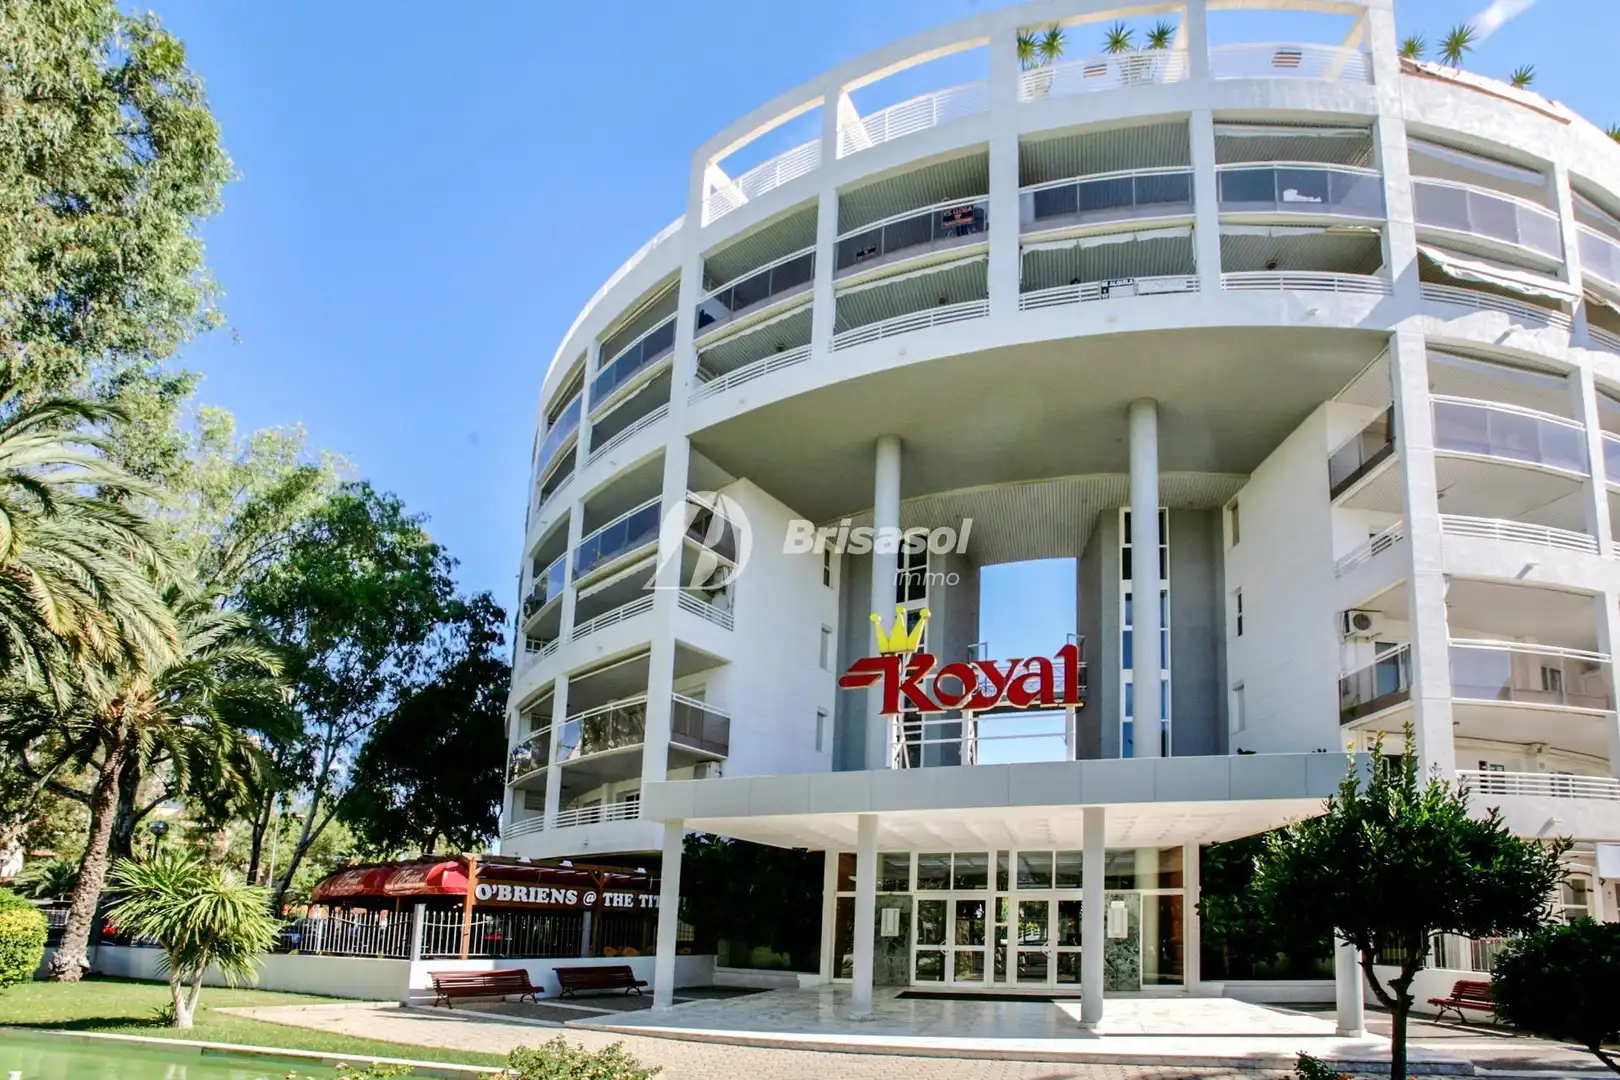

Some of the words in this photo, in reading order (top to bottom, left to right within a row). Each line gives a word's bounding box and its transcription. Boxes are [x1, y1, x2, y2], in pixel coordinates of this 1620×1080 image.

[839, 643, 1084, 715] Royal
[475, 883, 578, 905] O'BRIENS
[583, 891, 597, 906] @
[603, 892, 634, 908] THE
